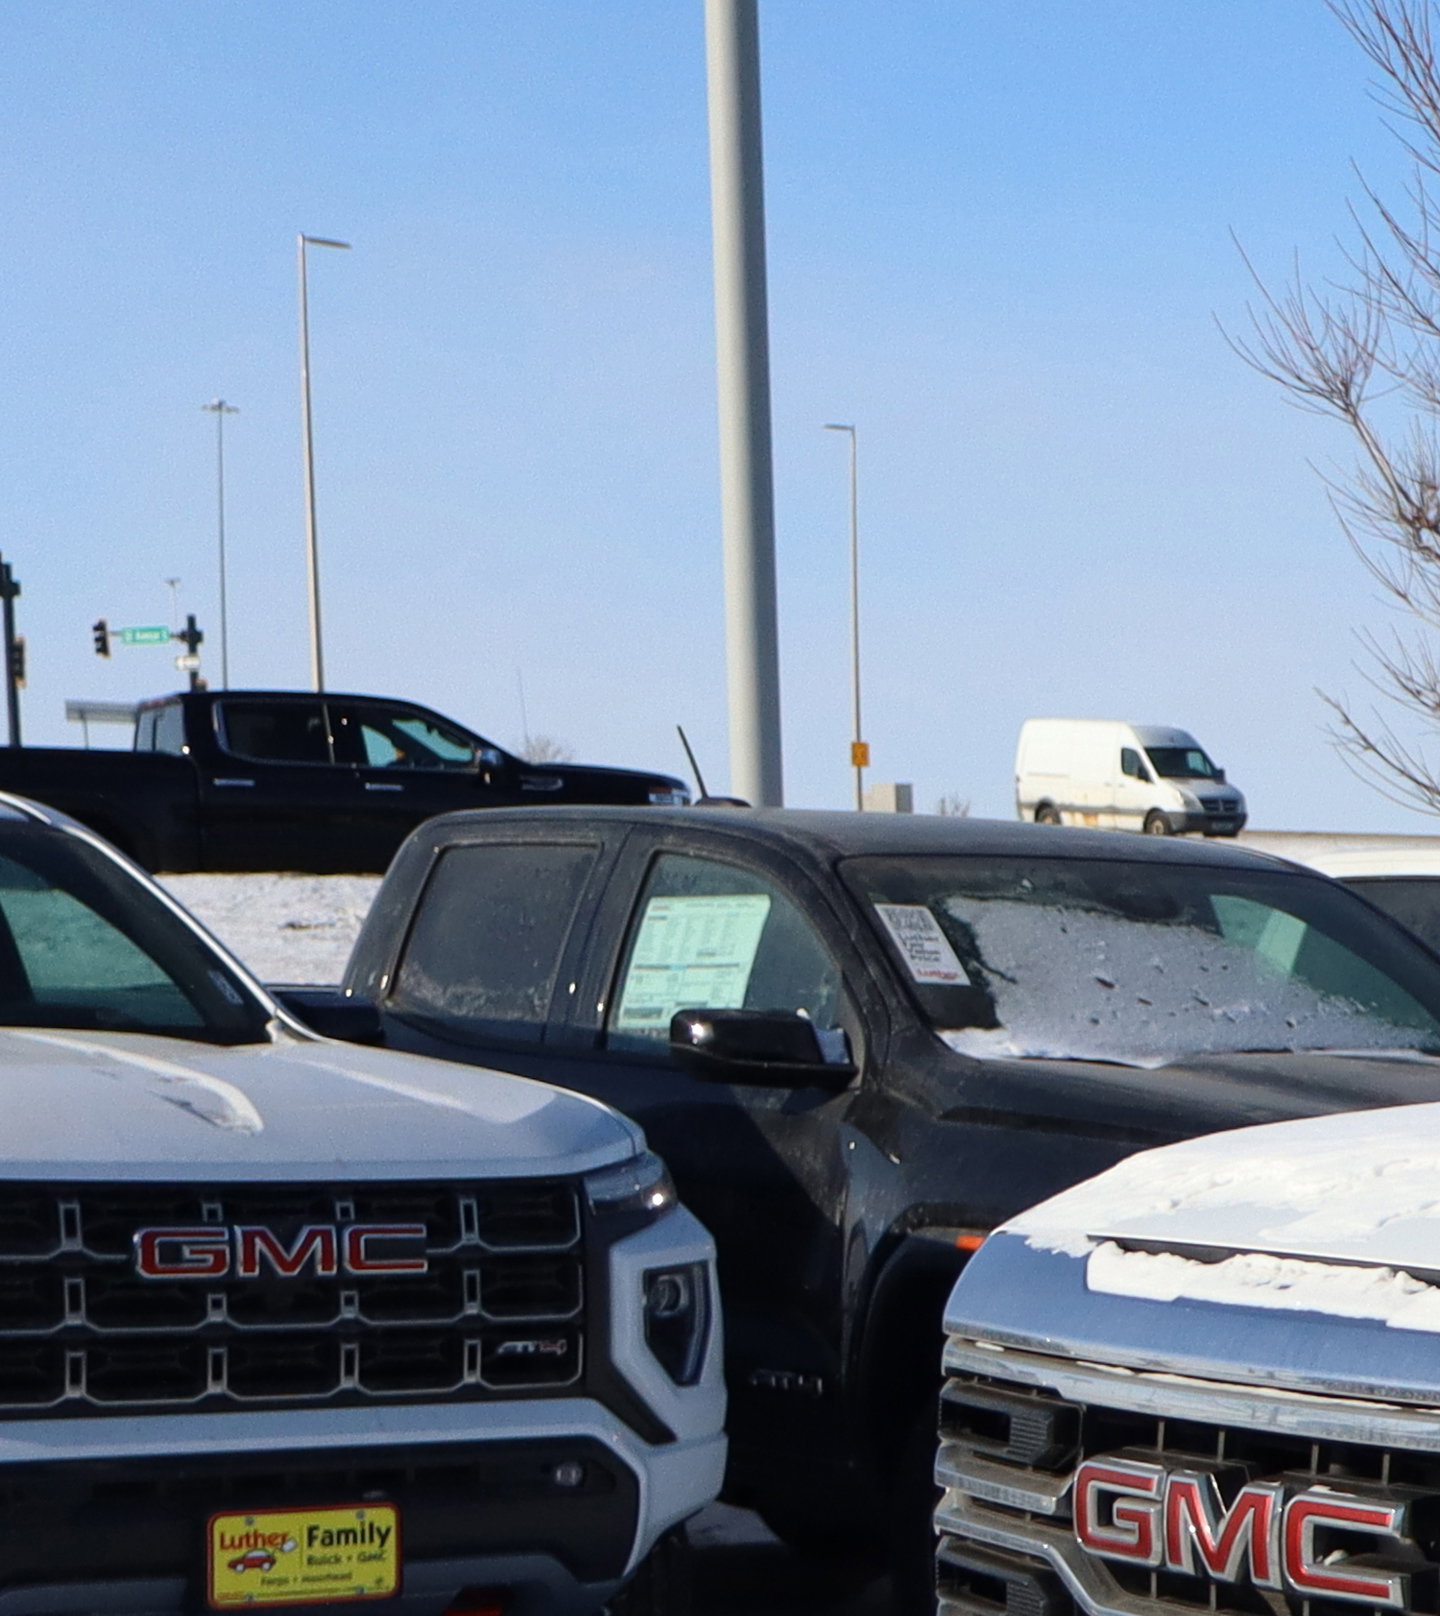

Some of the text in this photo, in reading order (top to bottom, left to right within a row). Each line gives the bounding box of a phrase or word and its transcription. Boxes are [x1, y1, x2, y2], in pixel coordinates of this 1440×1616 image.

[133, 1224, 428, 1279] GMC
[219, 1520, 392, 1550] Luther Family
[1072, 1453, 1405, 1605] GMC
